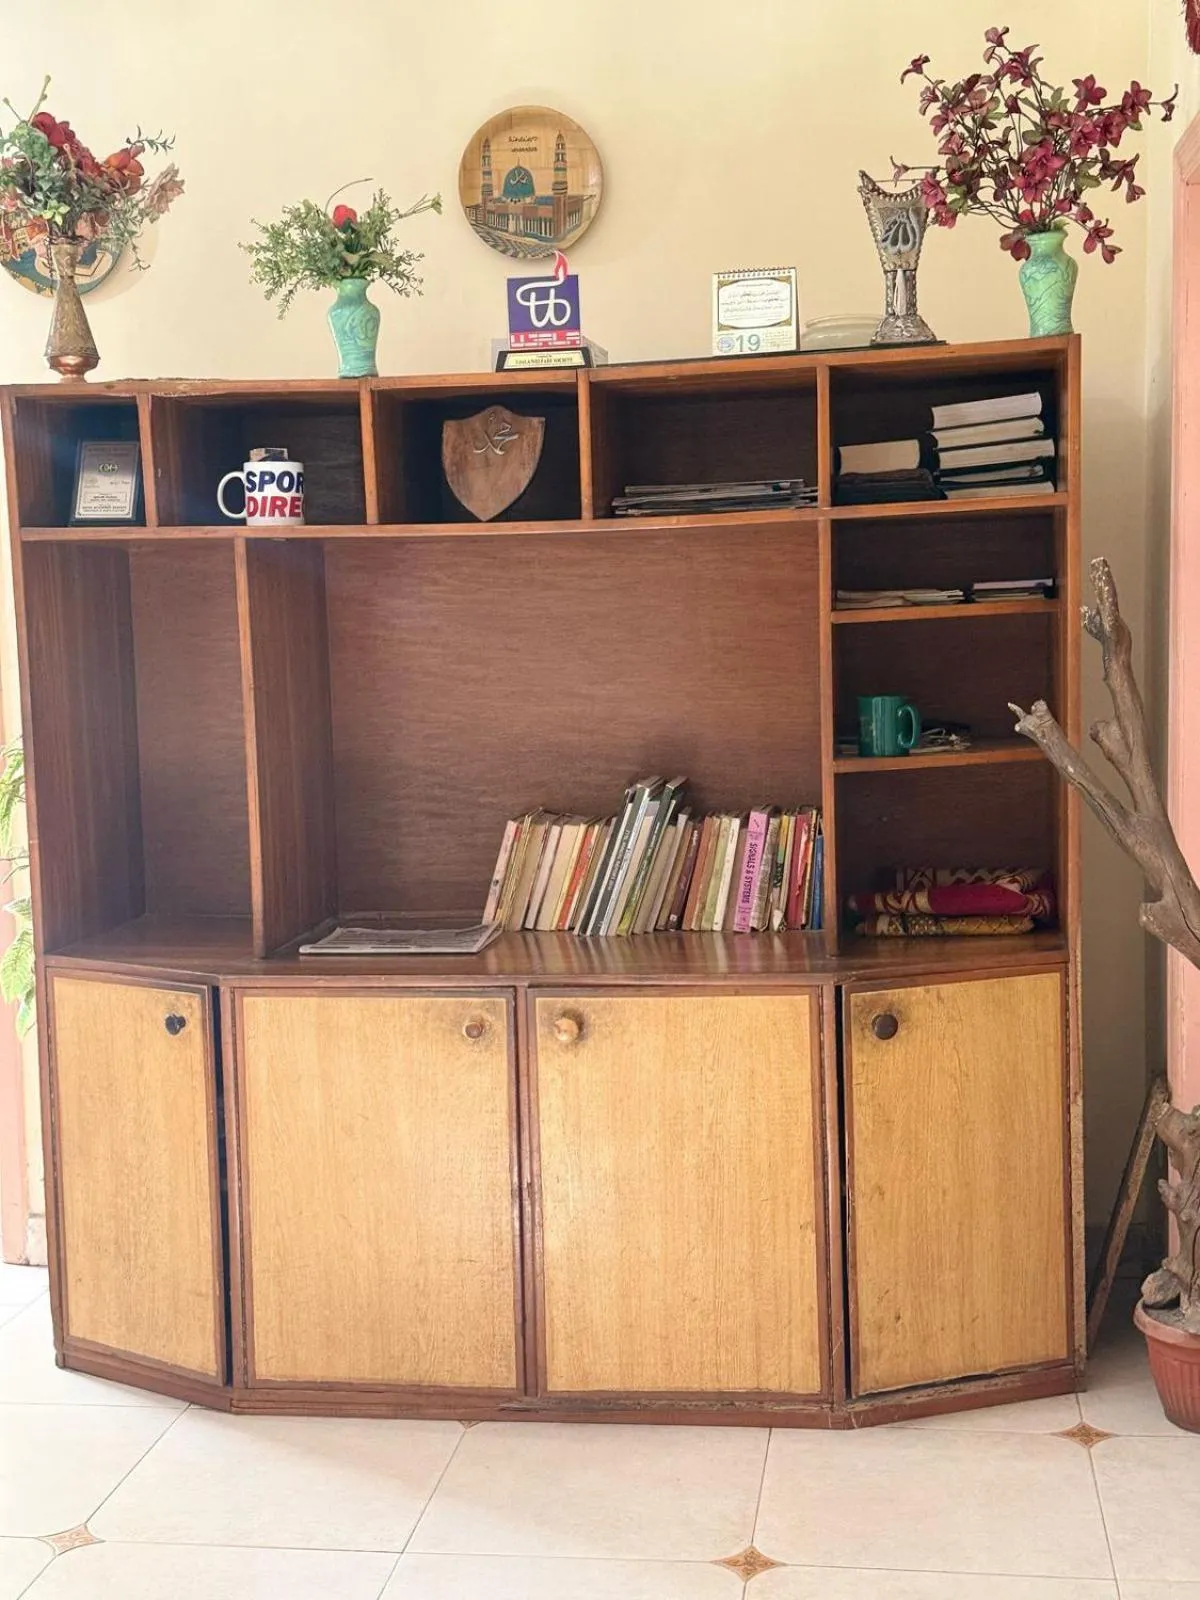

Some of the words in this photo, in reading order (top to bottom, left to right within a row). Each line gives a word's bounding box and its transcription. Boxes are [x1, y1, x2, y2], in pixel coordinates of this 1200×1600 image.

[736, 334, 760, 352] 19
[246, 496, 304, 517] DIRE
[746, 843, 758, 869] SIGNALS
[742, 876, 753, 904] SYSTEMS
